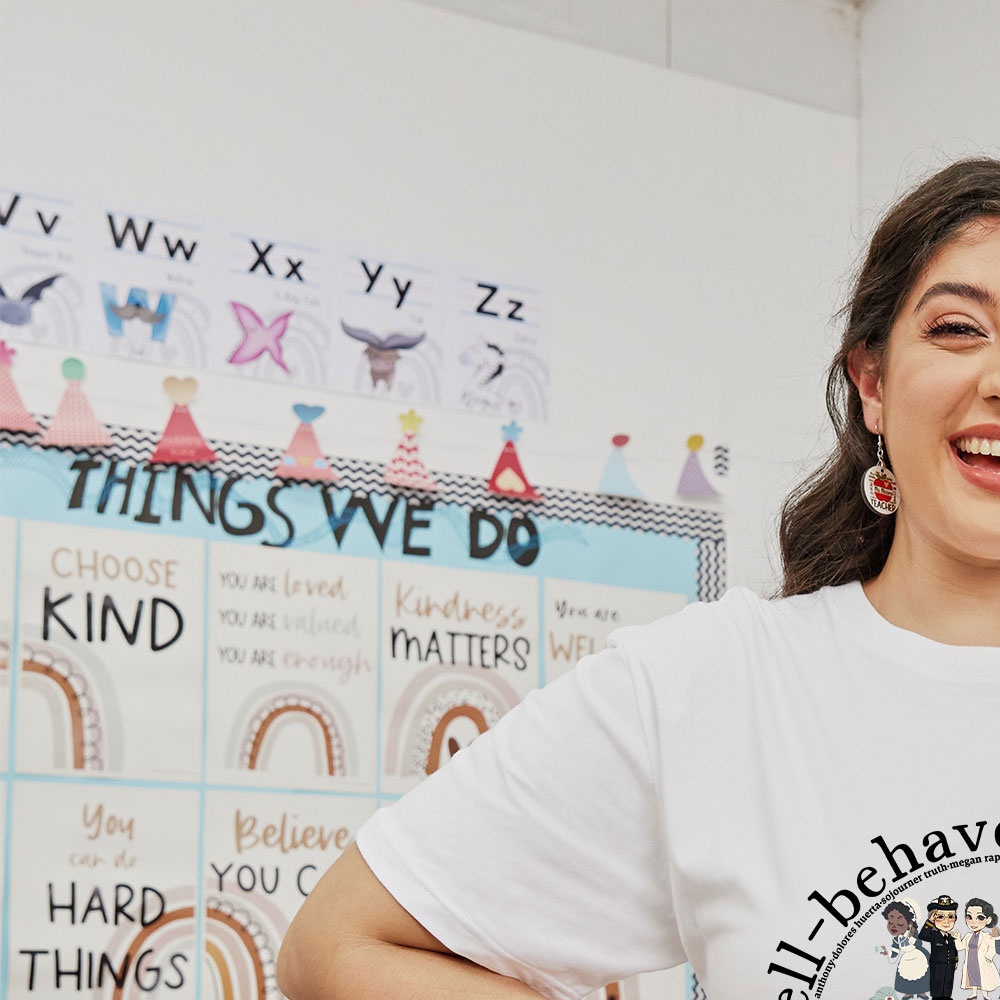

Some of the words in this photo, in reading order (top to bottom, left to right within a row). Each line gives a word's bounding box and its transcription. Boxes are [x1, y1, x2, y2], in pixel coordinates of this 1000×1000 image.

[67, 458, 295, 549] THINGS
[319, 489, 433, 557] WE
[469, 509, 542, 568] DO
[50, 546, 180, 590] CHOOSE
[218, 572, 246, 590] YOU
[251, 574, 276, 594] ARE
[283, 568, 349, 601] loved
[41, 587, 185, 651] KIND
[218, 608, 246, 627] YOU
[251, 611, 276, 631] ARE
[283, 611, 363, 638] valued
[394, 580, 527, 630] Kindness
[217, 645, 246, 665] YOU
[250, 648, 276, 668] ARE
[283, 651, 373, 685] enough
[81, 802, 135, 840] You
[234, 808, 350, 855] Believe
[210, 862, 280, 894] YOU
[48, 881, 166, 928] HARD
[19, 947, 189, 992] THINGS
